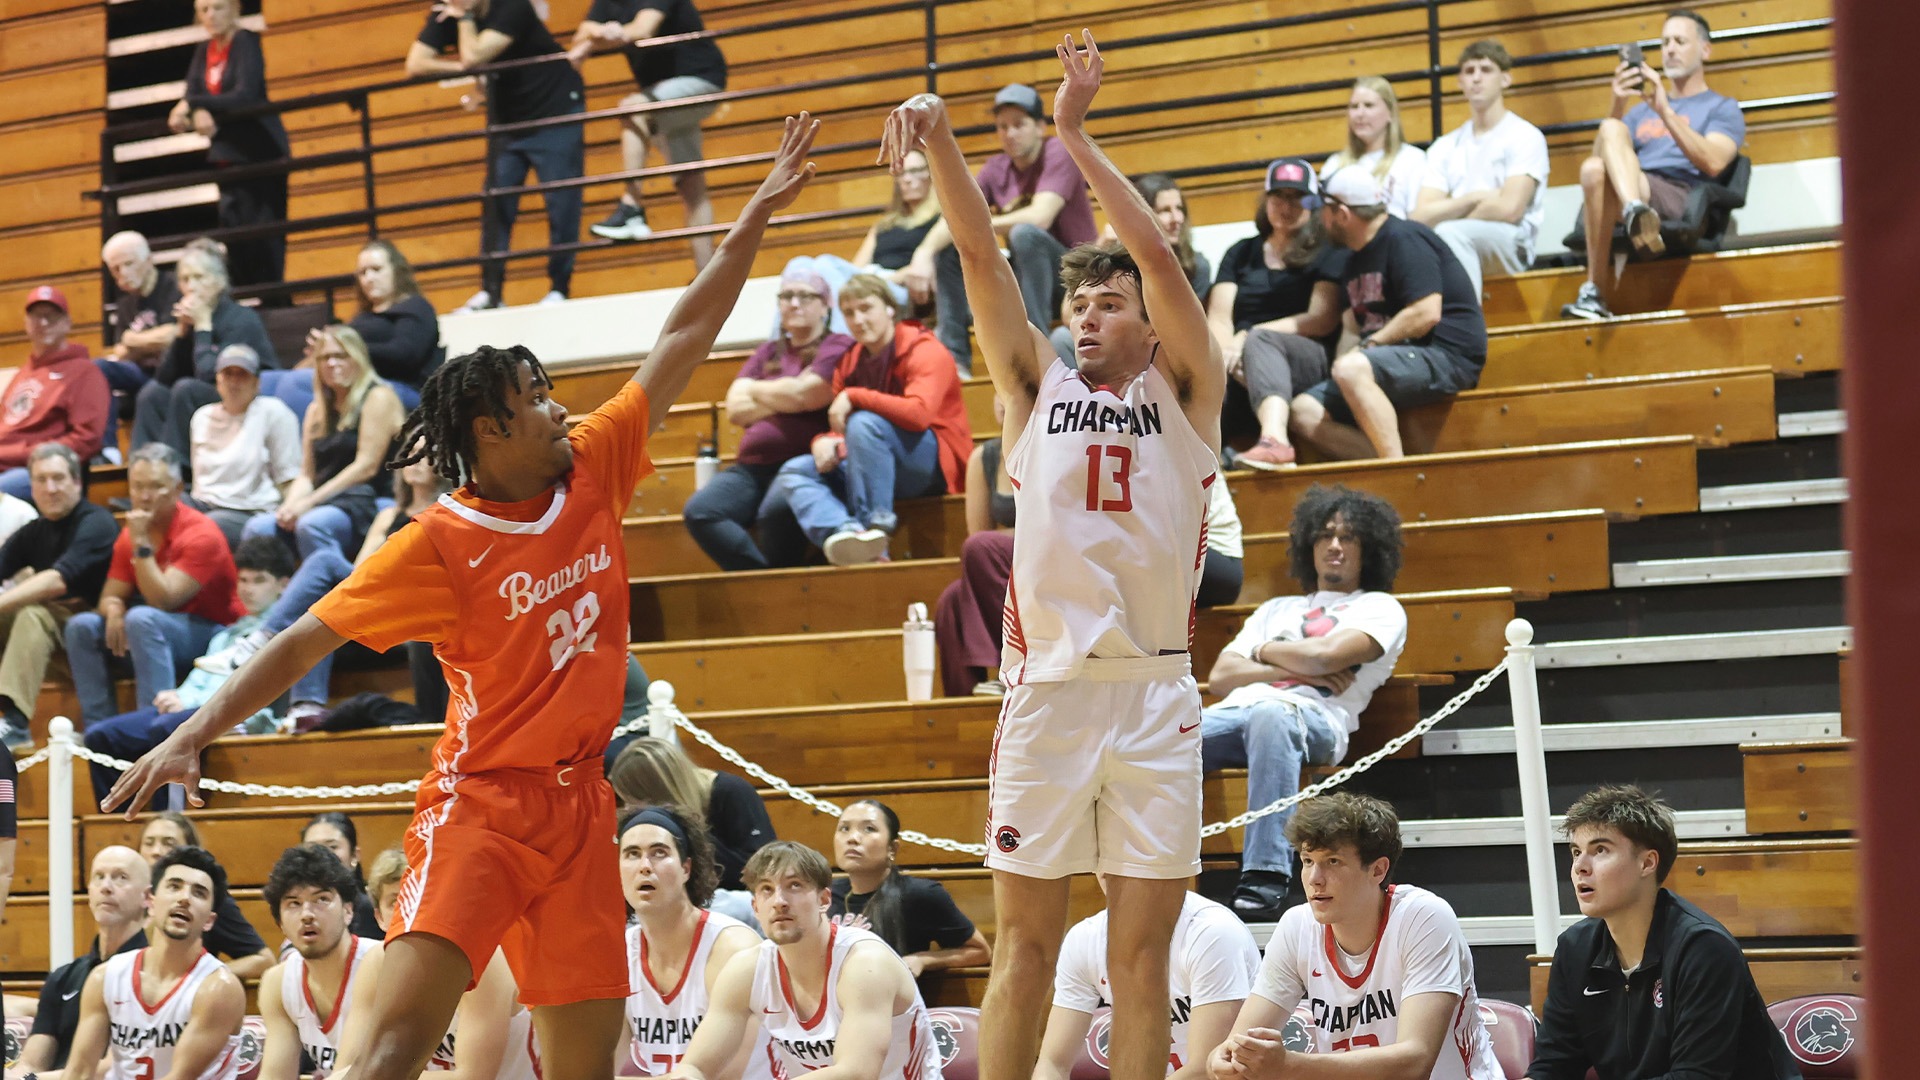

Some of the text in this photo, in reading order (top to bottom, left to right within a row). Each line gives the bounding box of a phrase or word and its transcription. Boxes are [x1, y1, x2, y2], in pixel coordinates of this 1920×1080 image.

[1047, 401, 1162, 438] CHAPMAN
[1086, 444, 1132, 512] 13
[498, 544, 611, 621] Beavers
[545, 591, 601, 671] 22
